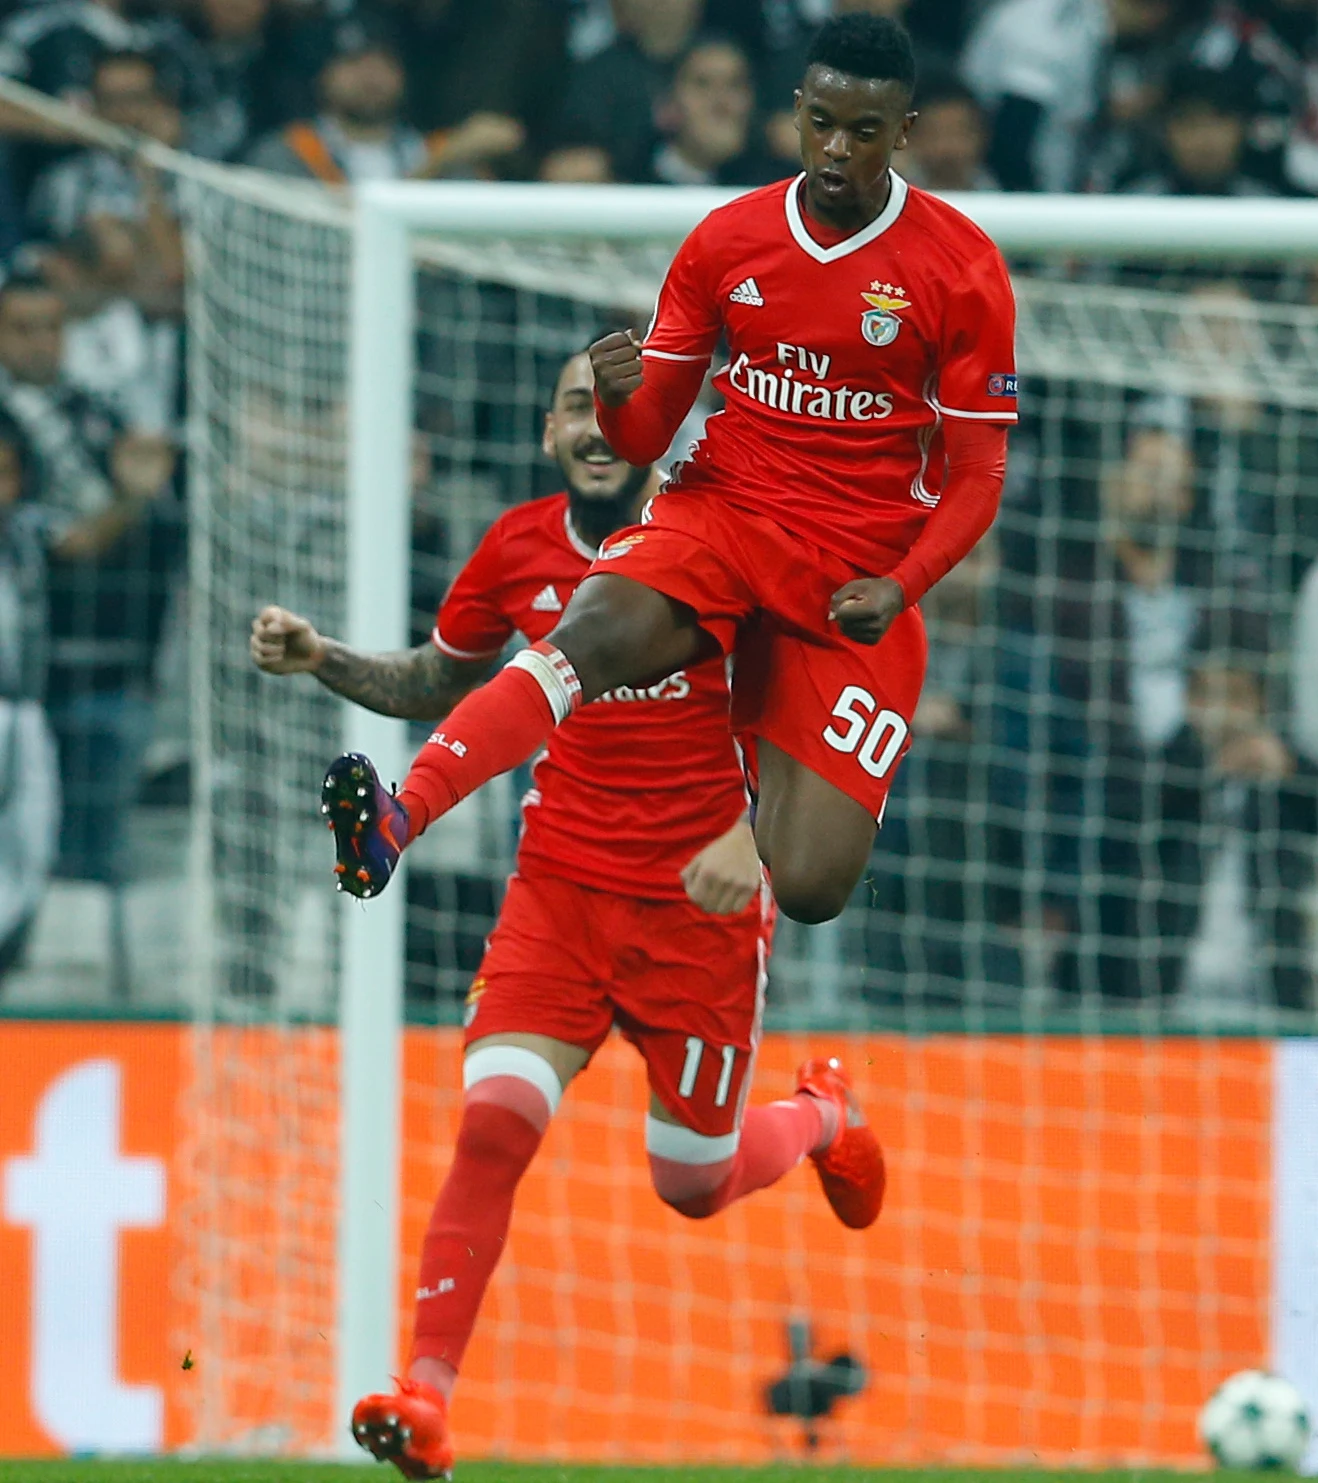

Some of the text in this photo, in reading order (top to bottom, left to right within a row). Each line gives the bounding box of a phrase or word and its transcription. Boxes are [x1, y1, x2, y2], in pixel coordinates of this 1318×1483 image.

[729, 292, 764, 306] adidas
[729, 352, 893, 421] Emirates
[776, 341, 831, 379] Fly
[426, 732, 468, 758] SLB
[821, 684, 909, 779] 50
[678, 1036, 737, 1107] 11
[2, 1058, 167, 1454] t
